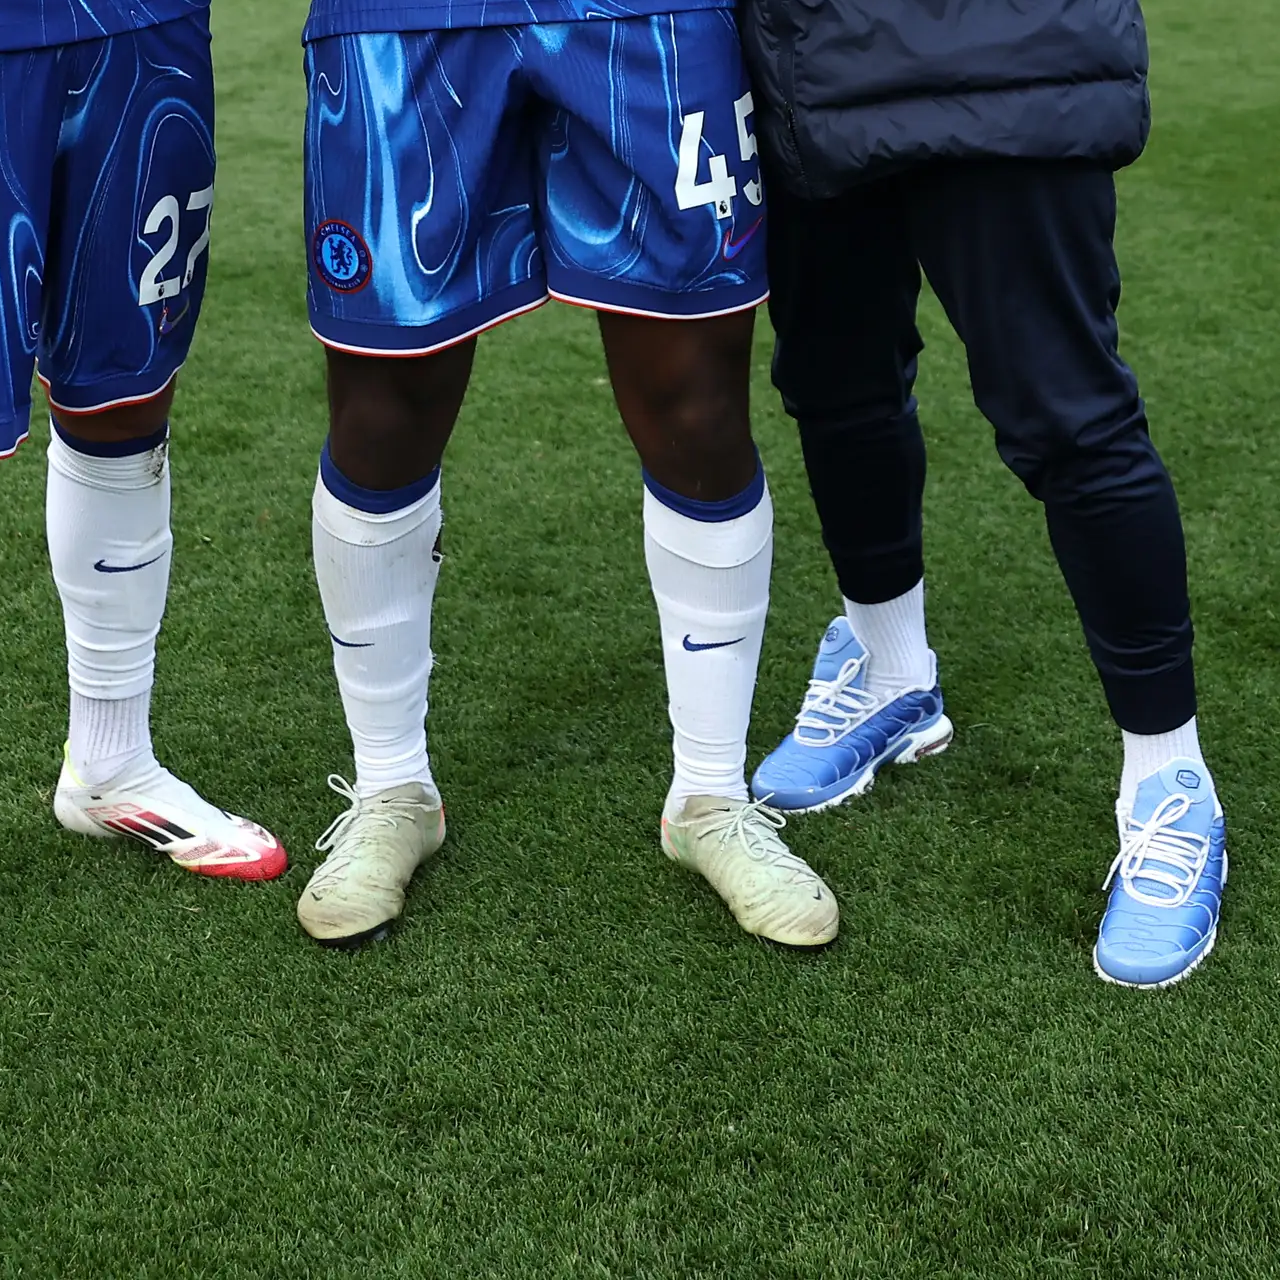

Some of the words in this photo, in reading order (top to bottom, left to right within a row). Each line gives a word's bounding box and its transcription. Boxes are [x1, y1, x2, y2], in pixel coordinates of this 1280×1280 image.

[674, 90, 763, 220] 45
[138, 183, 214, 307] 27
[320, 223, 357, 243] CHELSEA
